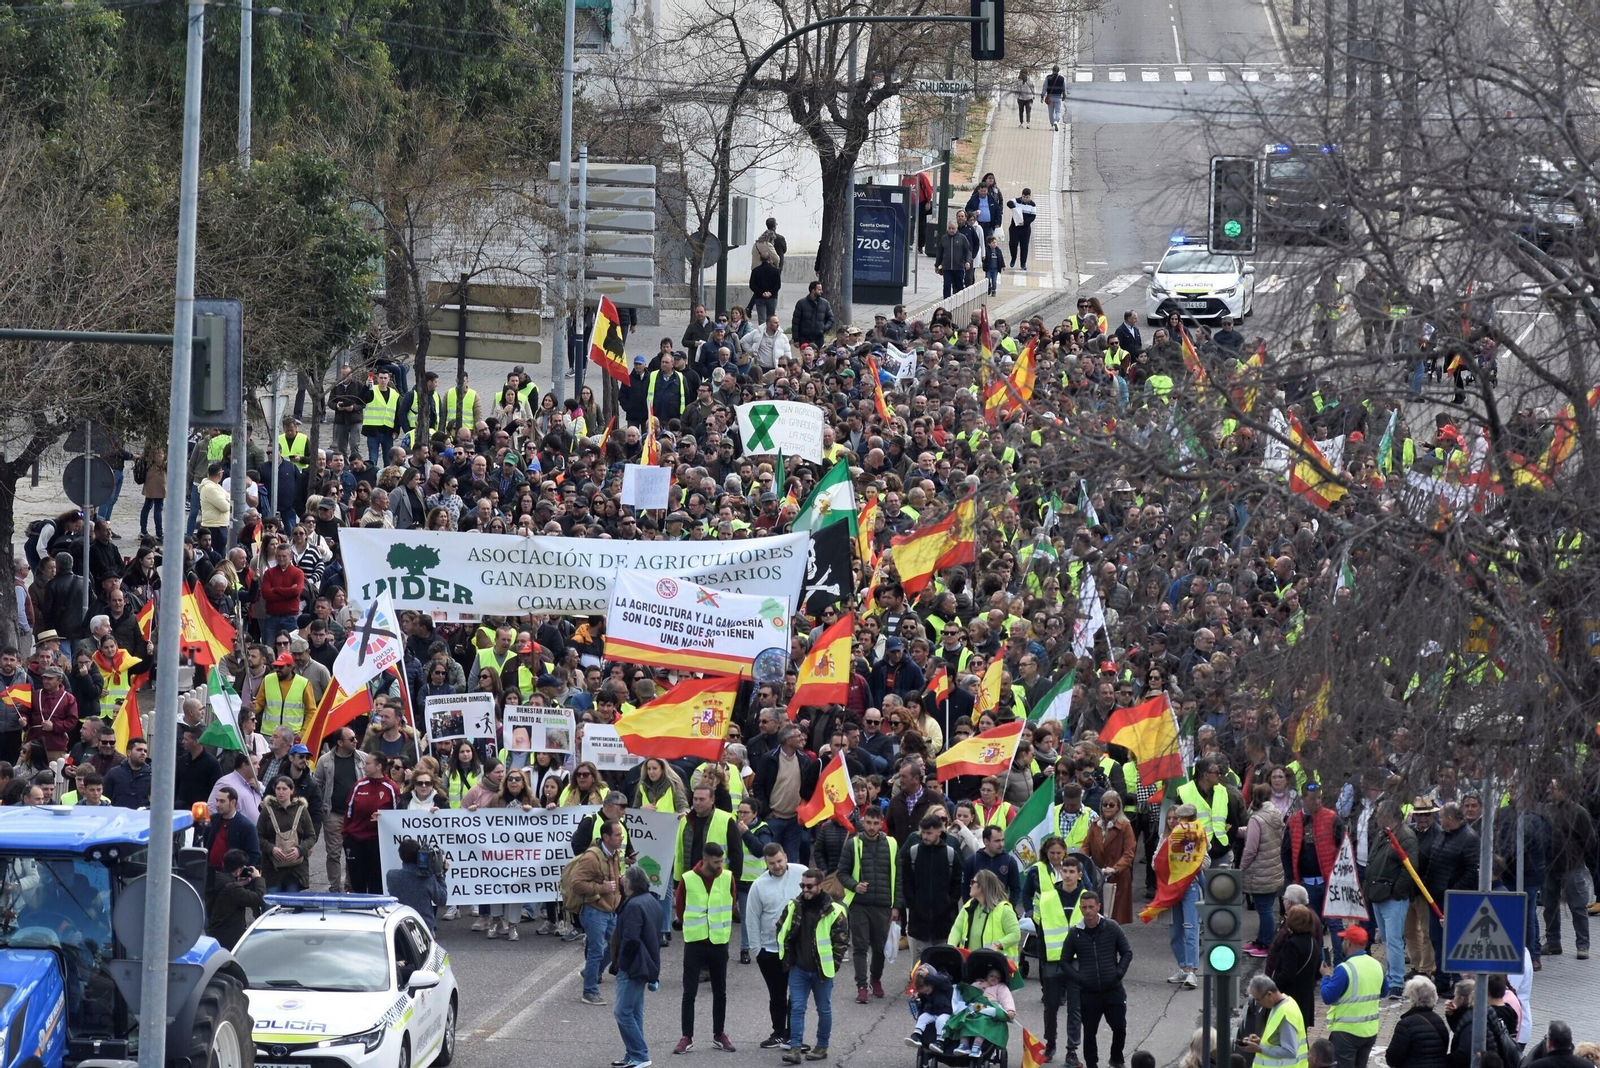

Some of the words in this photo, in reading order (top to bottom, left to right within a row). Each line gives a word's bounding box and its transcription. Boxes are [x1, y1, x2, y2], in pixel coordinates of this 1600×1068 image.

[467, 546, 592, 569] ASOCIACIÓN
[600, 553, 628, 569] DE
[634, 545, 794, 569] AGRICULTORES
[481, 569, 607, 591] GANADEROS
[517, 595, 609, 612] COMARC
[615, 596, 627, 608] LA
[629, 598, 693, 621] AGRICULTURA
[695, 611, 702, 622] Y
[703, 614, 714, 626] LA
[622, 611, 642, 624] SON
[644, 615, 662, 628] LOS
[664, 619, 685, 633] PIES
[686, 624, 704, 638] QUE
[660, 632, 679, 646] UNA
[516, 706, 543, 715] BIENESTAR
[544, 708, 564, 716] ANIMAL
[508, 715, 535, 723] MALTRATO
[401, 815, 481, 828] NOSOTROS
[485, 814, 548, 827] VENIMOS
[552, 813, 569, 826] DE
[417, 832, 487, 845] MATEMOS
[491, 832, 510, 844] LO
[514, 831, 544, 845] QUE
[547, 830, 573, 842] NOS
[628, 828, 658, 840] IDA.
[458, 850, 478, 862] LA
[481, 848, 541, 861] MUERTE
[545, 848, 574, 860] DEL
[1340, 847, 1349, 861] EL
[451, 866, 537, 879] PEDROCHES
[1332, 864, 1354, 877] CAMPO
[451, 884, 471, 896] AL
[474, 882, 534, 895] SECTOR
[1329, 885, 1341, 901] SE
[1341, 886, 1365, 907] MUERE
[255, 1019, 327, 1033] OLICÍA
